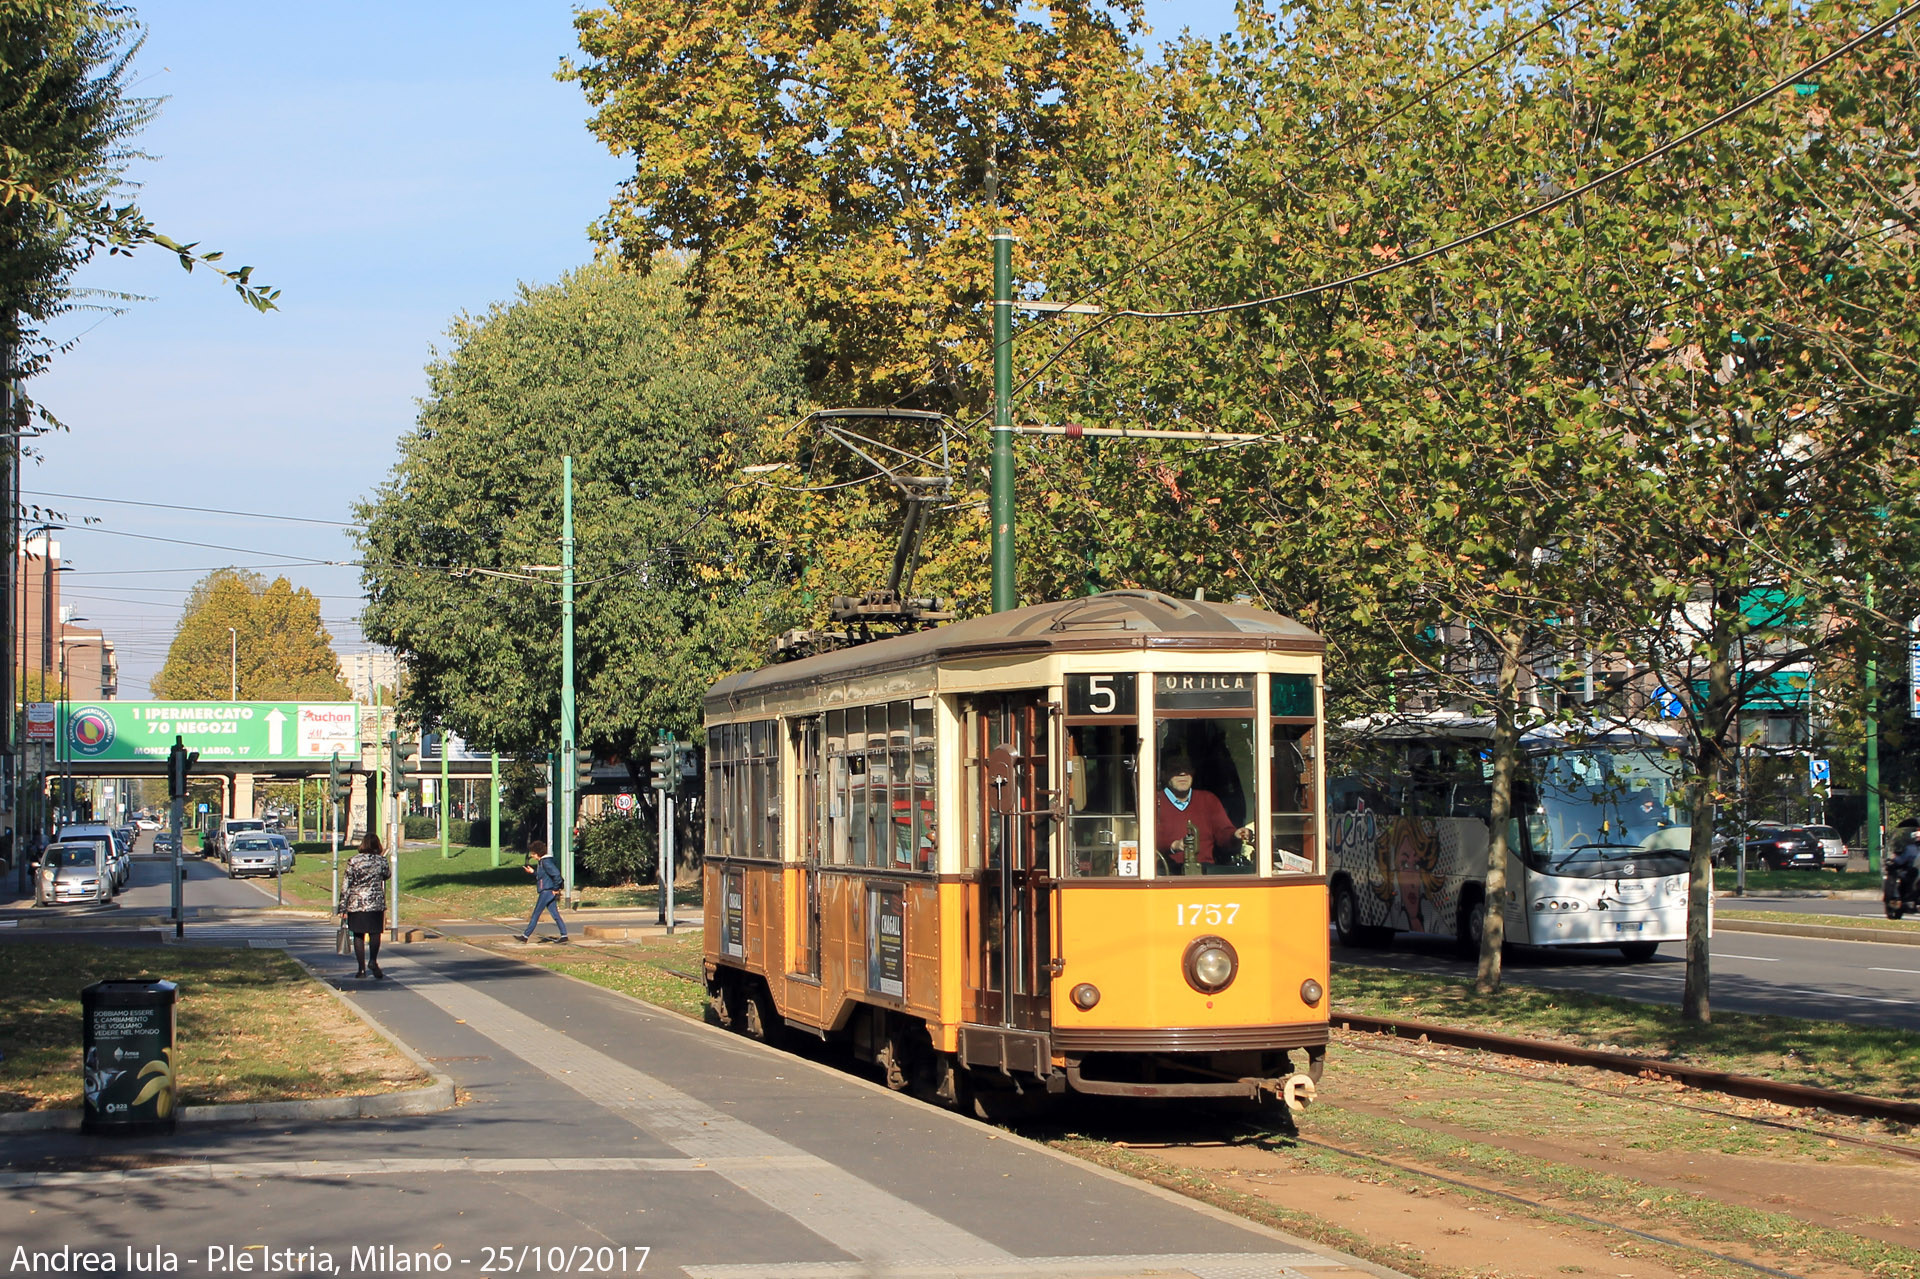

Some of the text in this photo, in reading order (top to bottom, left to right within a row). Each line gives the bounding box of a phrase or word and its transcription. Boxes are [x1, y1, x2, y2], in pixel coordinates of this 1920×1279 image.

[1166, 676, 1245, 689] ORTICA
[1089, 675, 1116, 713] 5
[132, 708, 254, 720] 1 IPERMERCATO
[303, 710, 351, 722] Auchan
[147, 722, 238, 734] 70 NEGOZI
[202, 747, 234, 755] LARIO,
[620, 798, 629, 806] 50
[1126, 849, 1132, 859] 3
[1126, 863, 1132, 874] 5
[1177, 904, 1241, 926] 1757
[881, 915, 901, 936] CHAGALL
